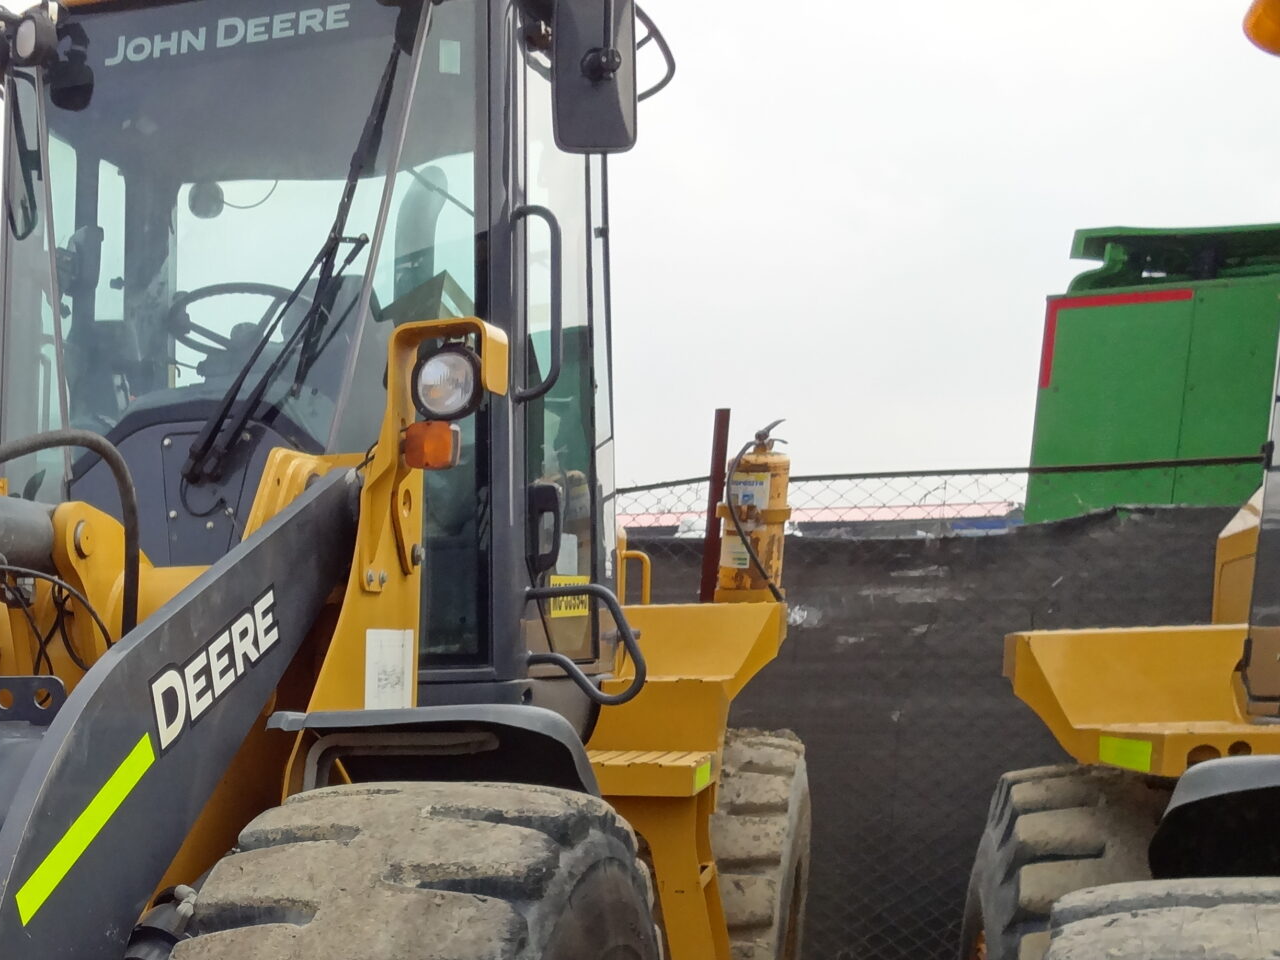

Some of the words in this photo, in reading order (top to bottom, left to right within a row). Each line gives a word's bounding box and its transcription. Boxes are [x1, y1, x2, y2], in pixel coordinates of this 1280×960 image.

[104, 27, 206, 66] JOHN
[216, 3, 351, 48] DEERE
[151, 589, 279, 750] DEERE
